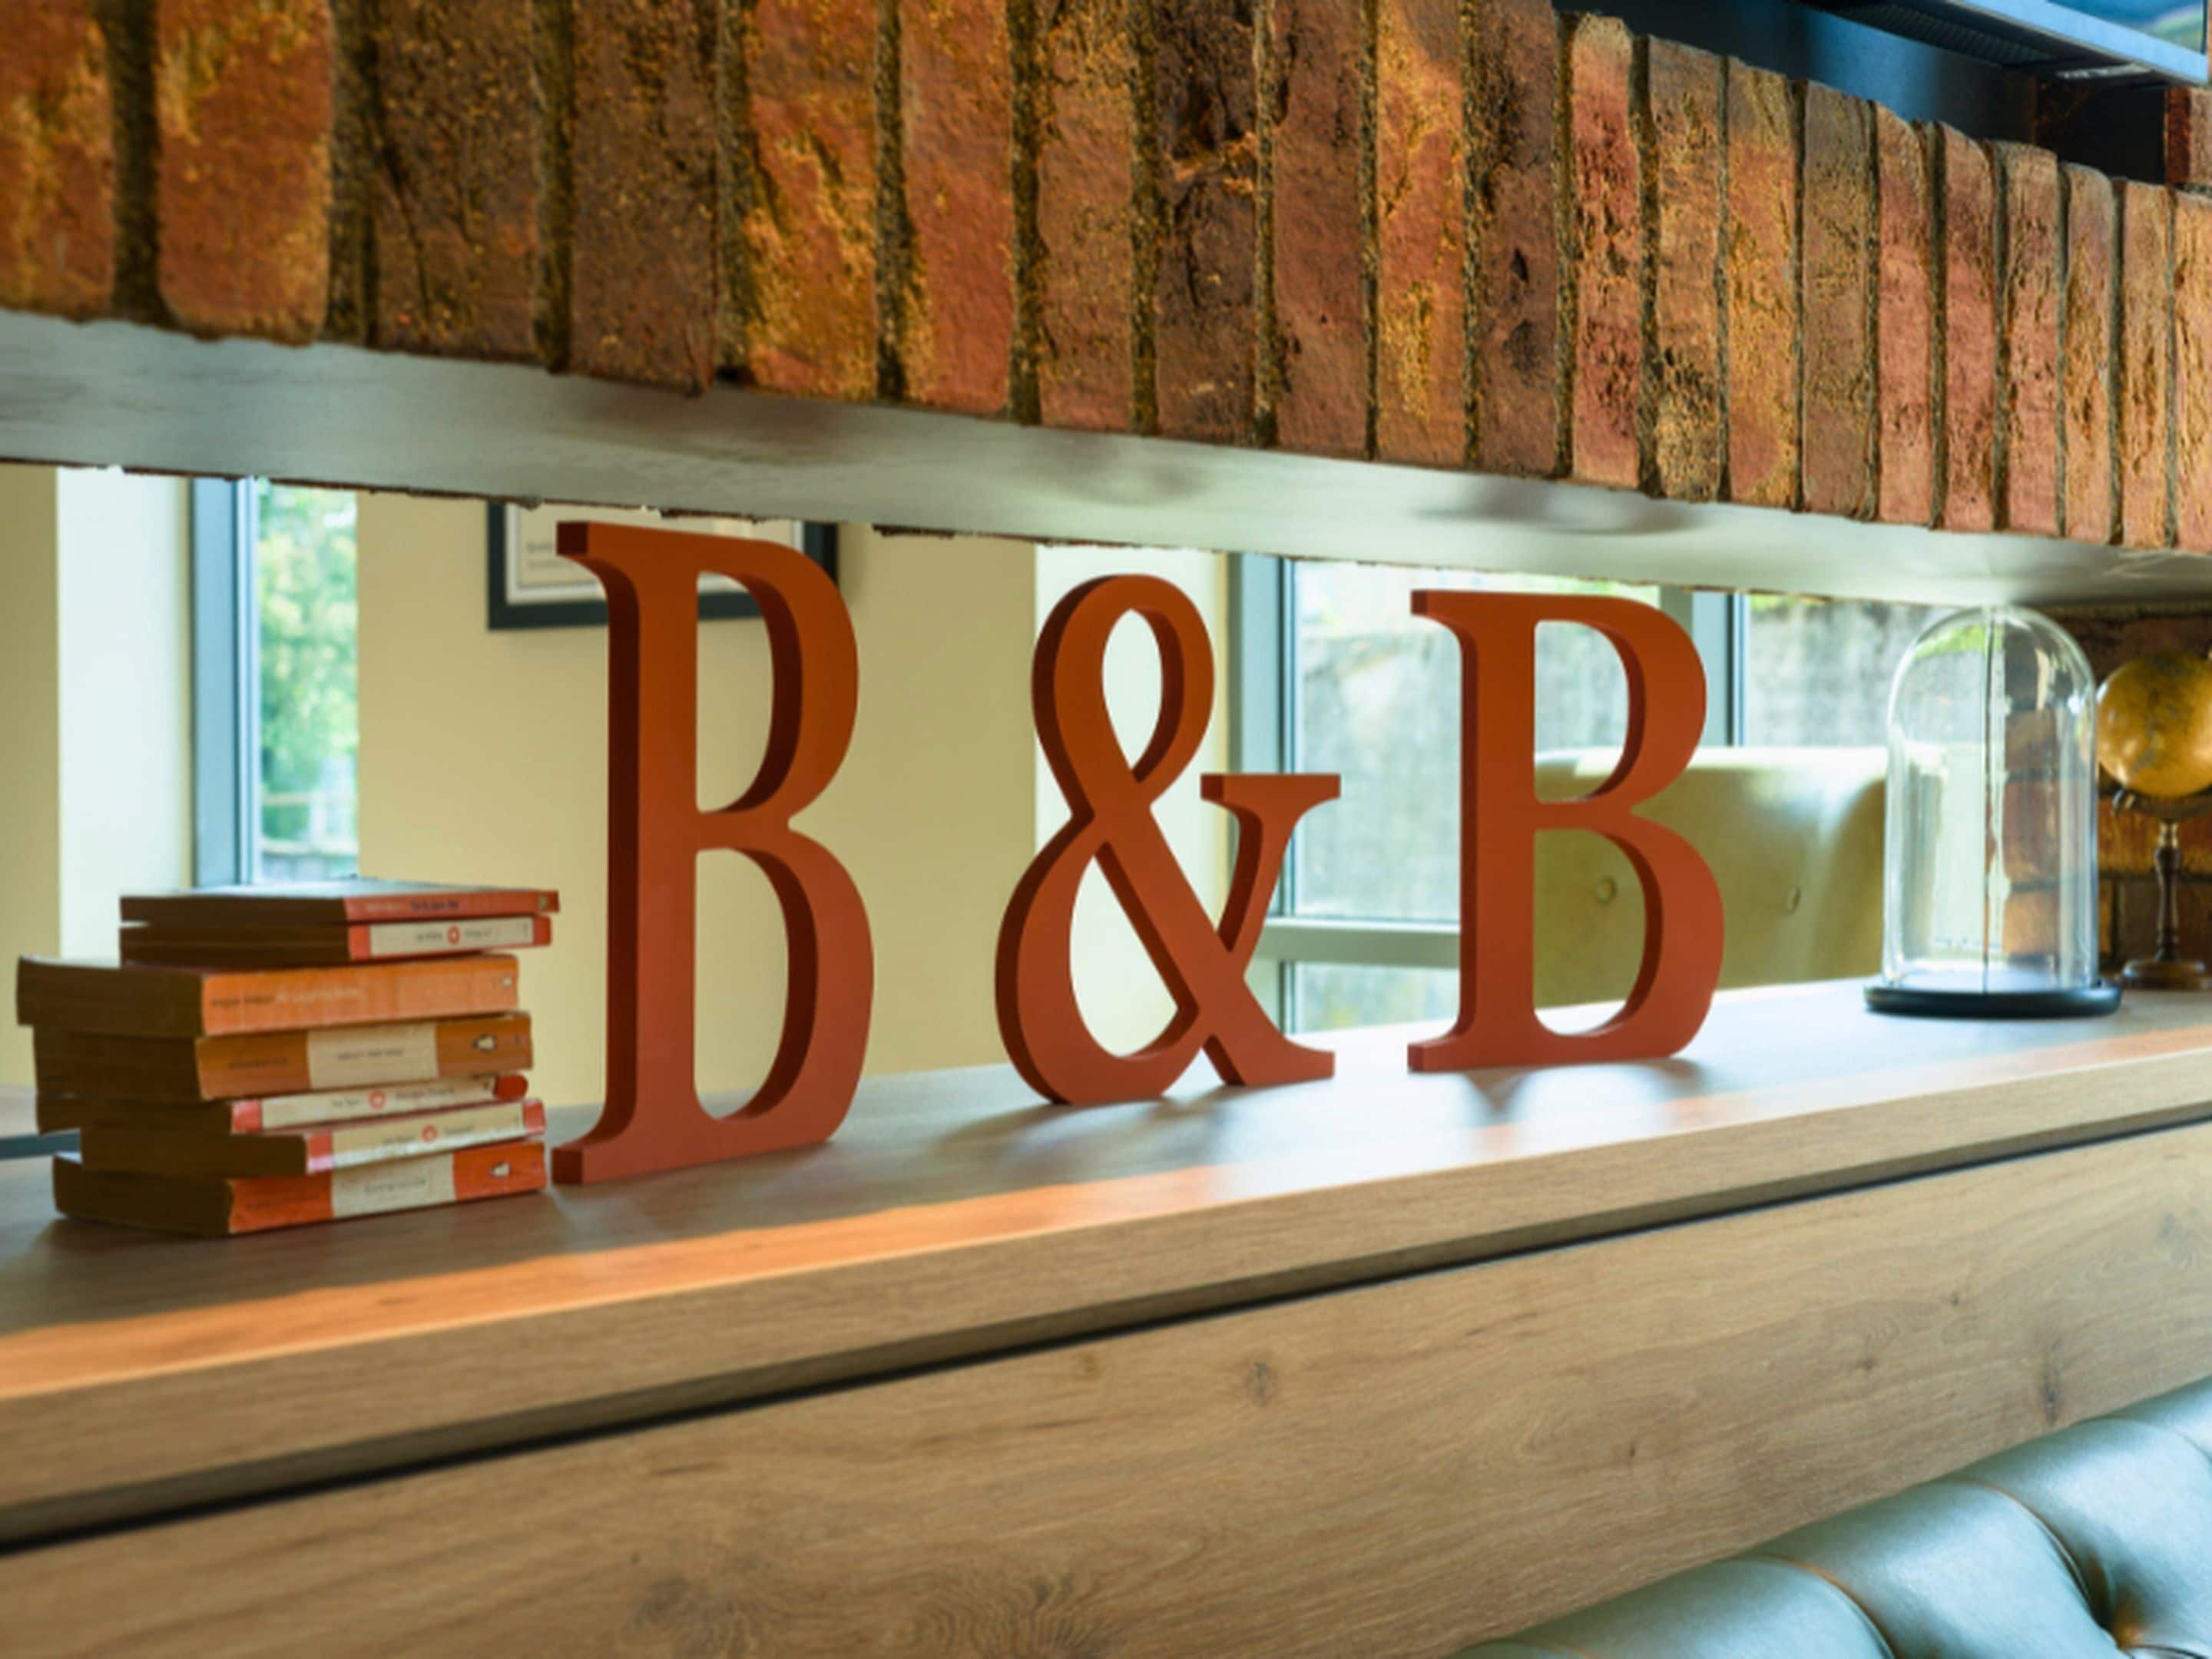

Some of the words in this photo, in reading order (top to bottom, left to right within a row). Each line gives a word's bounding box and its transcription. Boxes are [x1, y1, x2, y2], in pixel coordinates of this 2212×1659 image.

[551, 521, 875, 1184] B
[995, 575, 1340, 1104] &
[1408, 589, 1724, 1072] B
